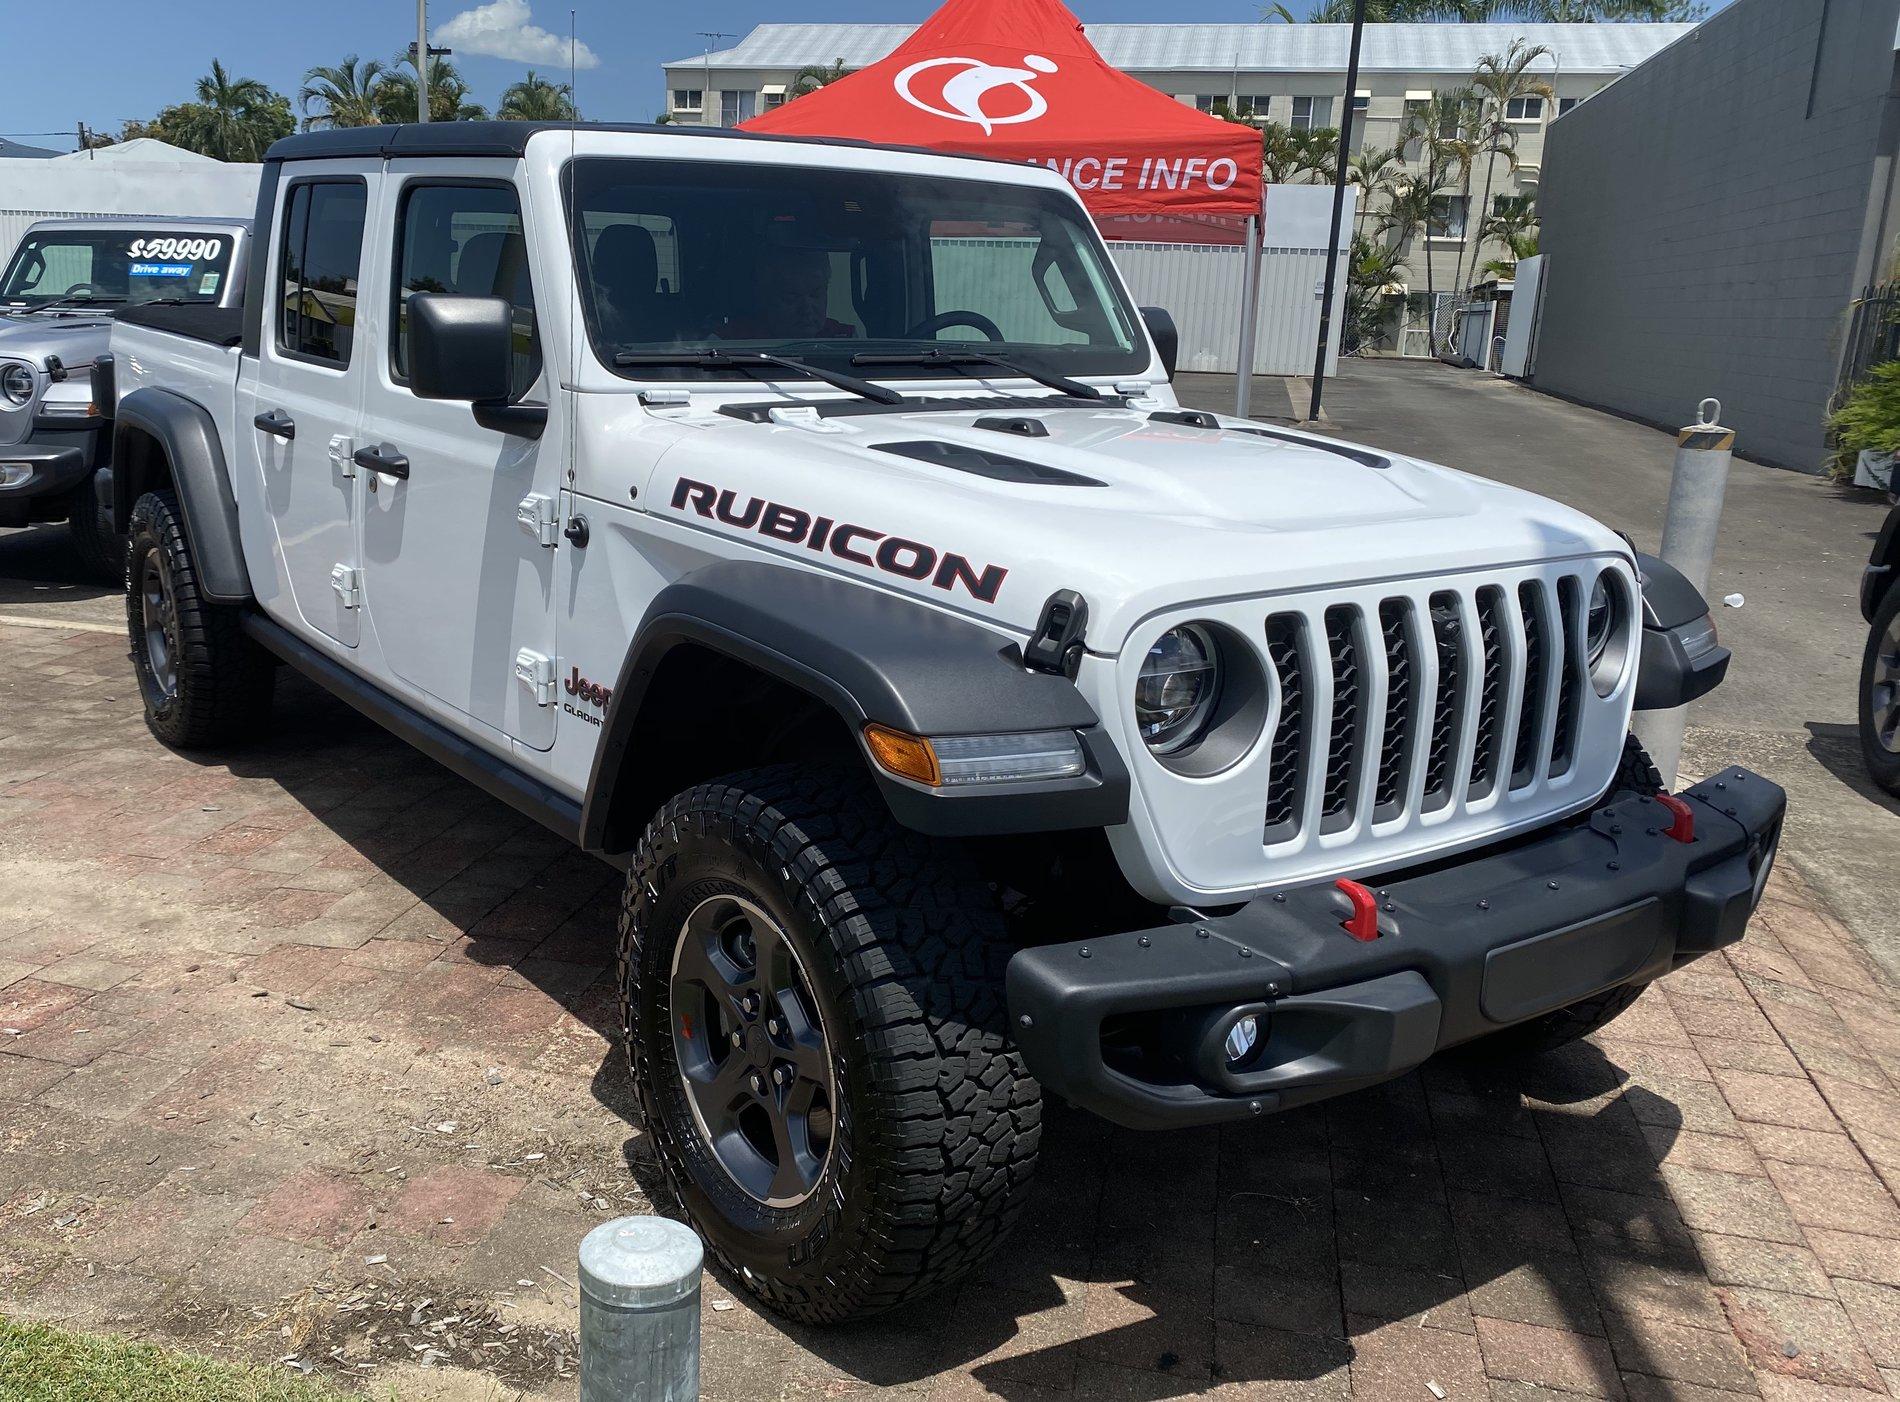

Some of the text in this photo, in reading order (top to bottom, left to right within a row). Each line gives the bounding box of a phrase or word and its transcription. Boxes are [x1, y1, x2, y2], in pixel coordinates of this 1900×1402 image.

[1138, 157, 1238, 190] INFO
[126, 238, 221, 260] $59990
[132, 264, 190, 276] Drive away
[670, 476, 1009, 604] RUBICON
